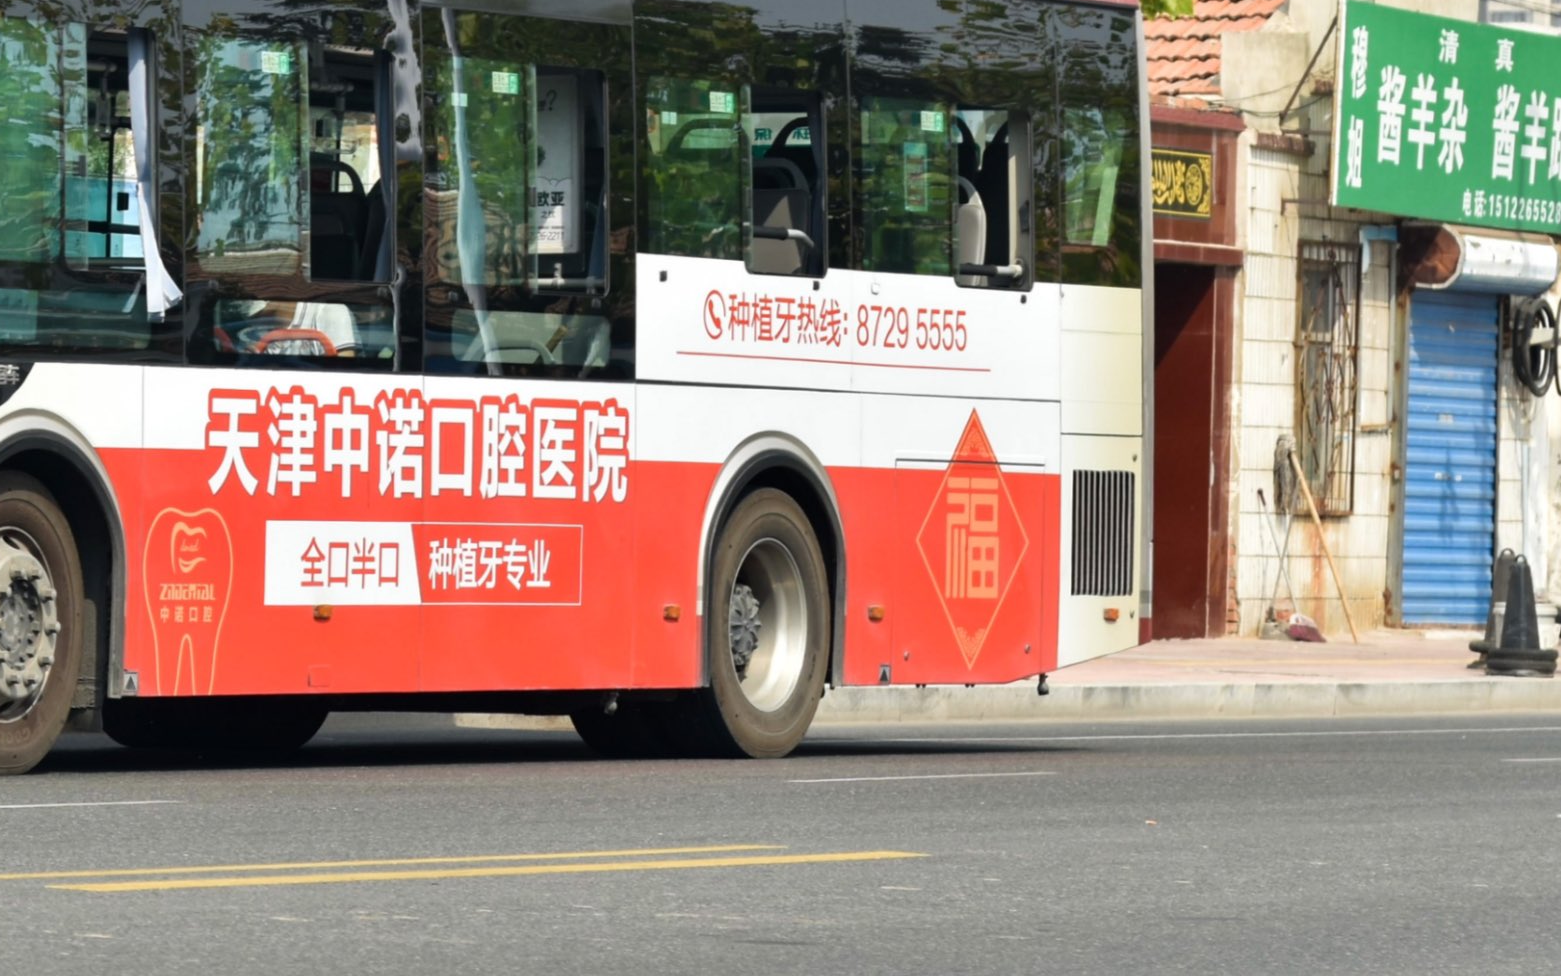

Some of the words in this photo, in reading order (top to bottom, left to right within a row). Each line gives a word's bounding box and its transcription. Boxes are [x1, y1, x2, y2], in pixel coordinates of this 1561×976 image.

[1439, 28, 1514, 72] 清真
[1346, 25, 1369, 188] 穆姐
[1377, 65, 1469, 174] 酱羊杂
[856, 304, 909, 349] 8729
[916, 309, 968, 352] 5555
[207, 394, 629, 504] 天津中诺口腔医院
[300, 537, 400, 590] 全口半口
[428, 538, 552, 591] 种植牙专业
[160, 606, 213, 623] 中诺口腔
